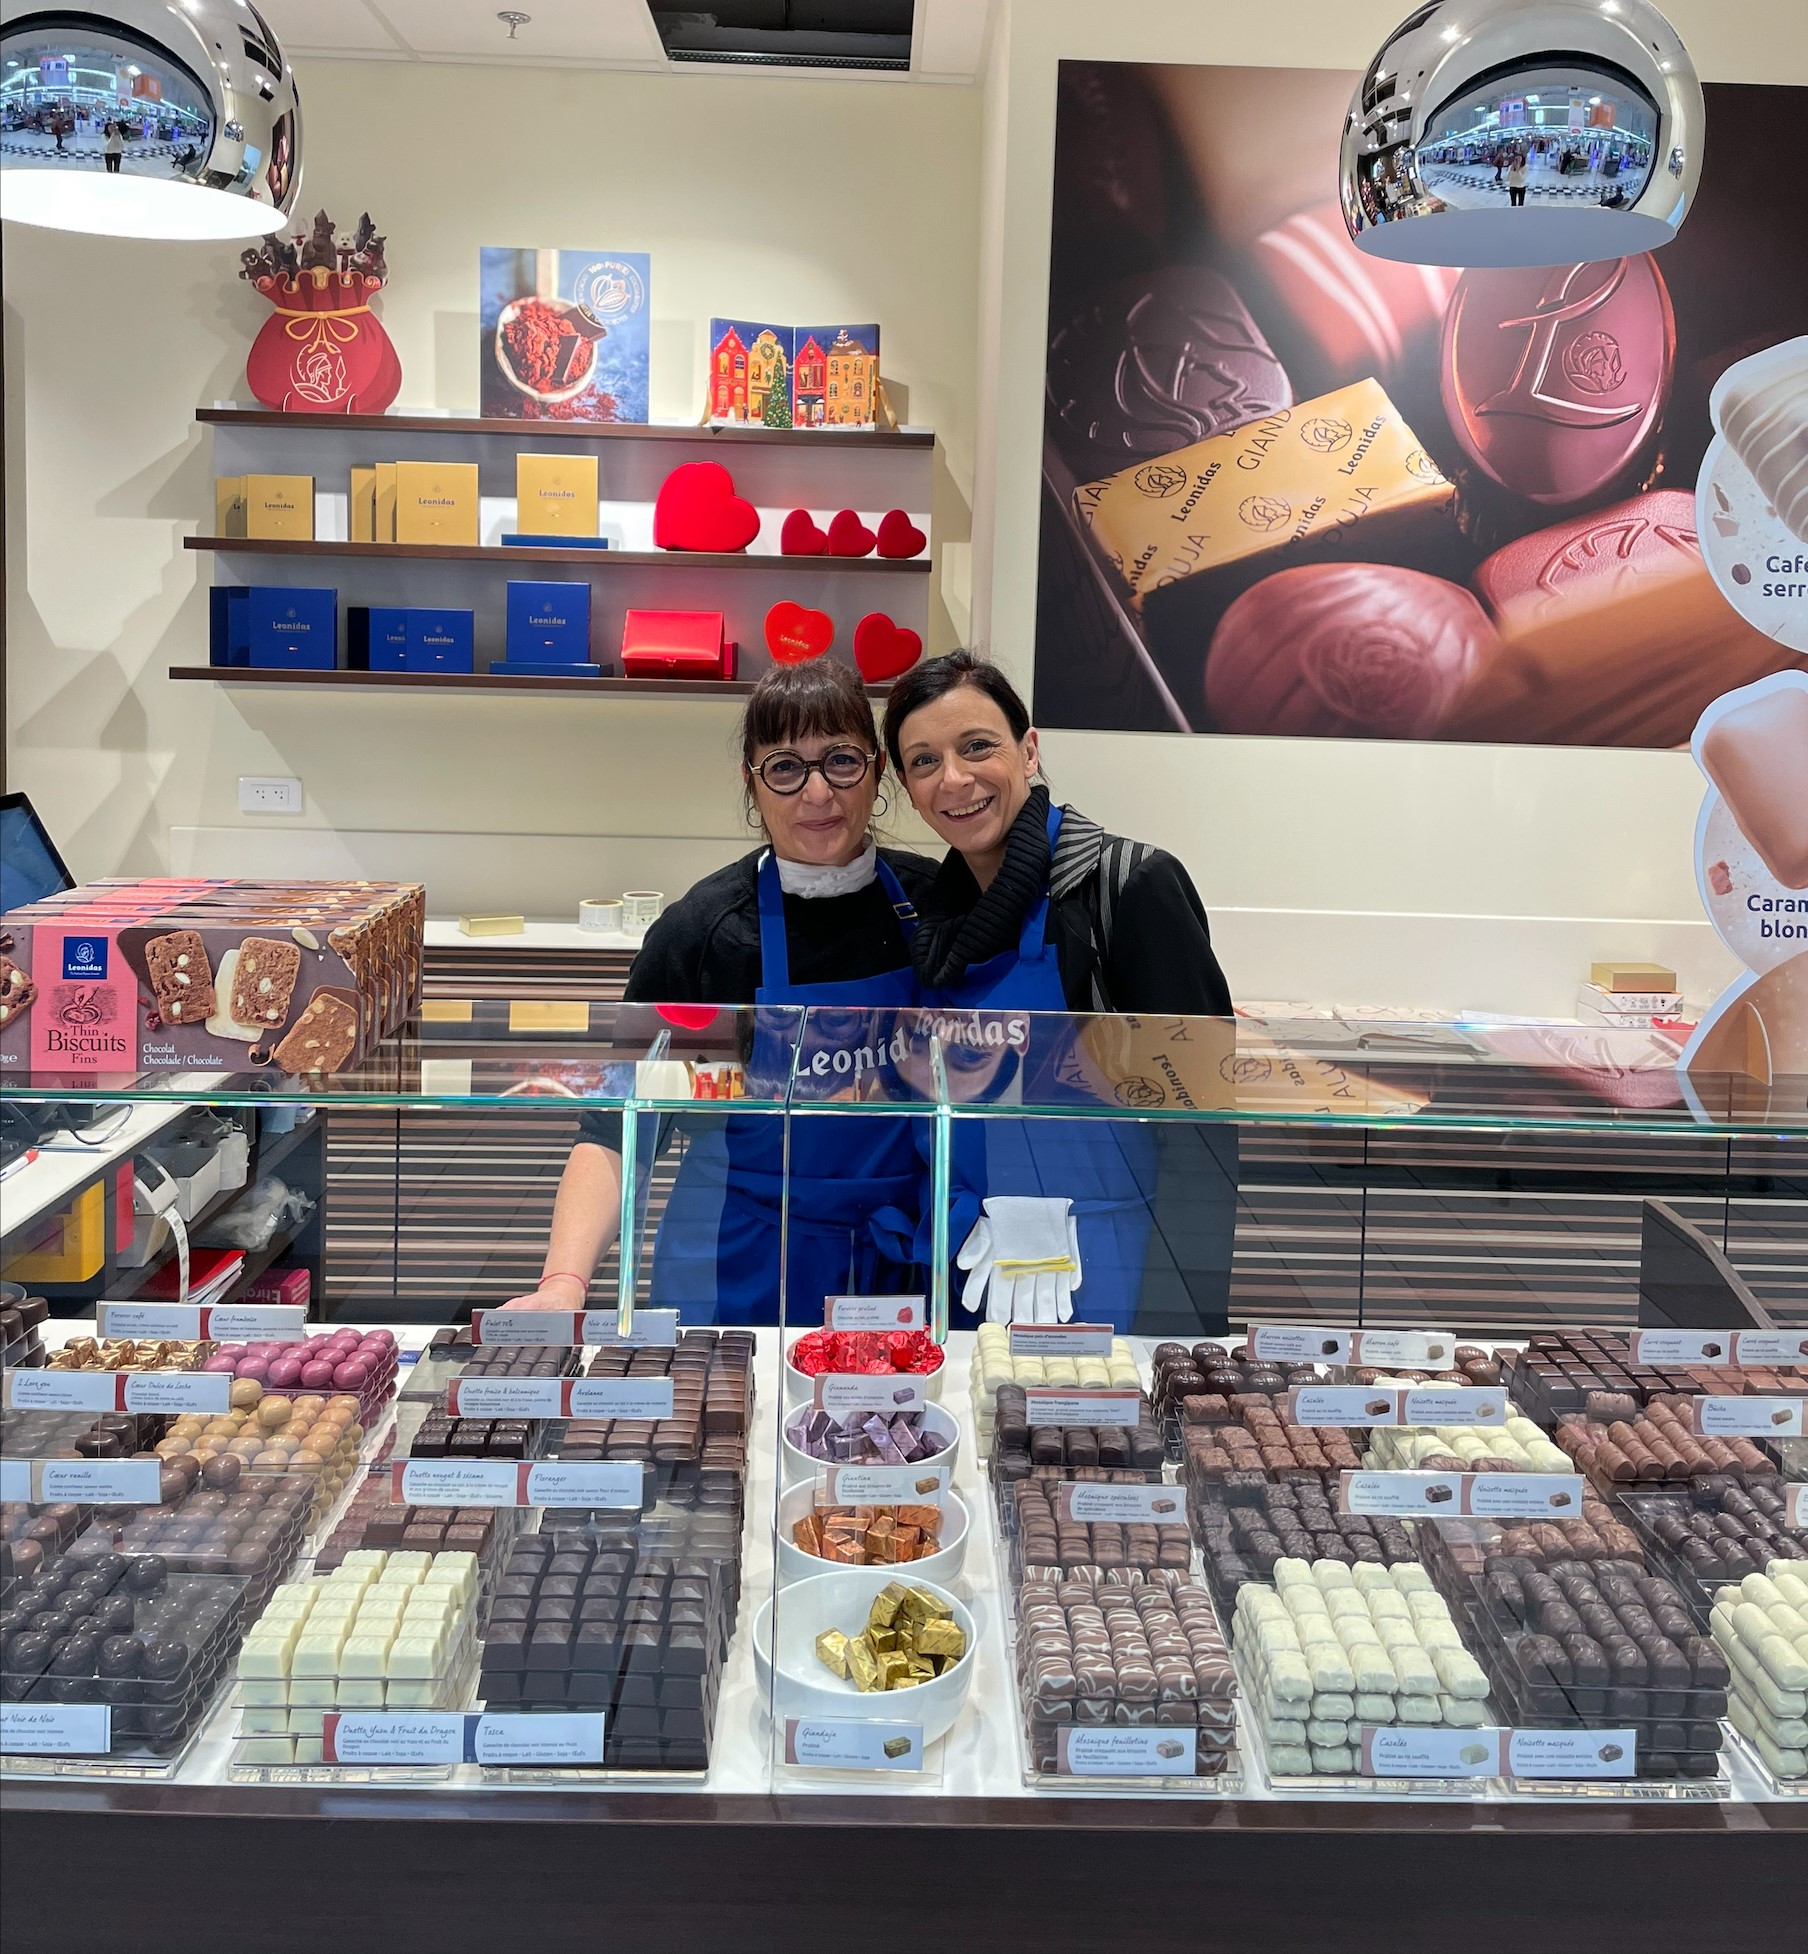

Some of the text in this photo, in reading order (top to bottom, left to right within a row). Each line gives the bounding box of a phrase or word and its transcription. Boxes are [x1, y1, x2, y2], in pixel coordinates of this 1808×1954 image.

[1237, 409, 1292, 470] GIAND
[1338, 415, 1386, 477] Leonidas
[1171, 461, 1222, 522] Leonidas
[418, 497, 455, 505] Leonidas
[1763, 583, 1808, 597] serr
[529, 615, 566, 624] Leonidas
[272, 621, 310, 630] Leonidas
[424, 636, 454, 644] Leonidas
[70, 1024, 99, 1036] Thin
[45, 1029, 127, 1053] Biscuits
[143, 1043, 175, 1053] Chocolat
[71, 1053, 98, 1064] Fins
[143, 1054, 181, 1065] Chocolade
[187, 1054, 223, 1065] Chocolate
[1388, 1339, 1401, 1348] café
[148, 1381, 165, 1389] Dulce
[409, 1470, 431, 1478] Duetto
[433, 1472, 454, 1482] nougat
[11, 1713, 25, 1723] Noir
[28, 1715, 36, 1723] de
[39, 1713, 55, 1723] Noir
[343, 1725, 366, 1734] Duetto
[398, 1725, 417, 1734] Fruit
[418, 1726, 428, 1734] du
[430, 1725, 456, 1739] Dragon
[484, 1726, 504, 1735] Tosca
[802, 1728, 837, 1743] Gianduja
[1517, 1738, 1575, 1750] Noisette masquée
